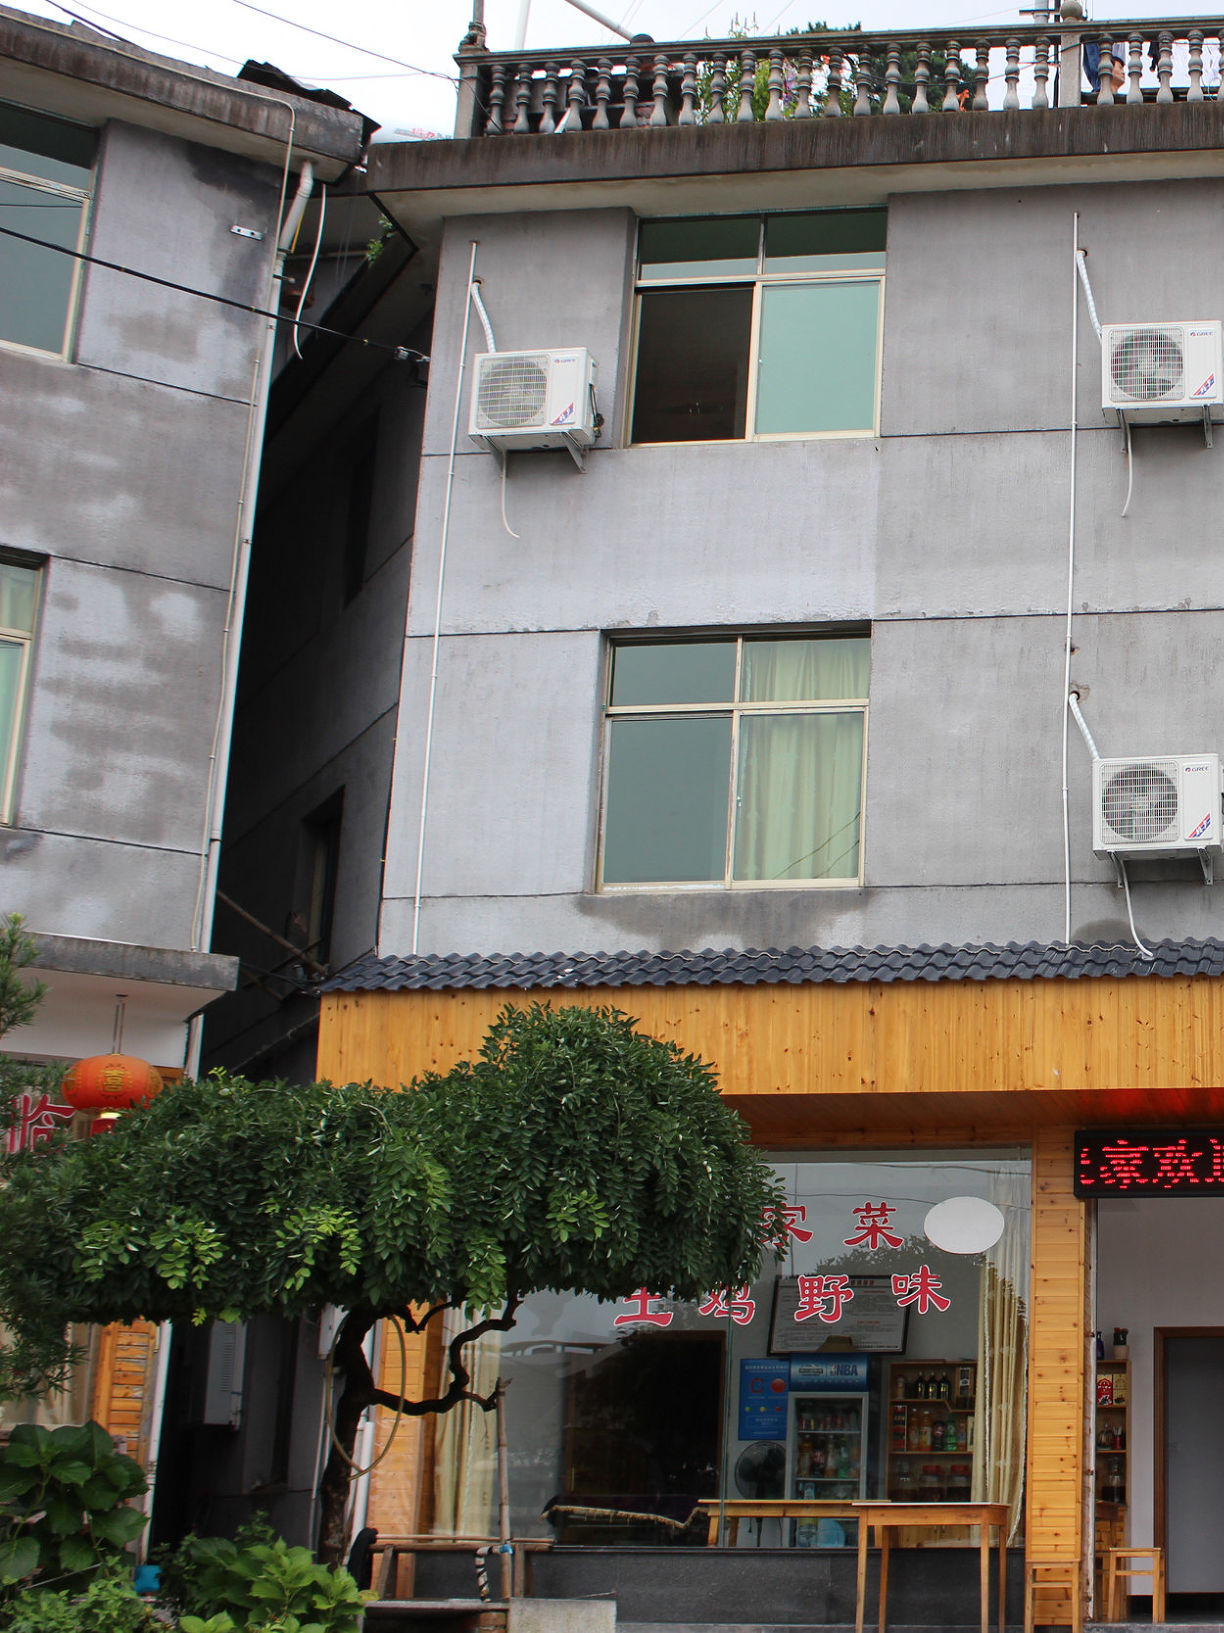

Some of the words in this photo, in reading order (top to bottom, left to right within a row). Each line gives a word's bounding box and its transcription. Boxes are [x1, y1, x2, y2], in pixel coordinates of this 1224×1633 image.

[614, 1264, 951, 1327] 土鸡野味
[836, 1364, 859, 1376] NBA
